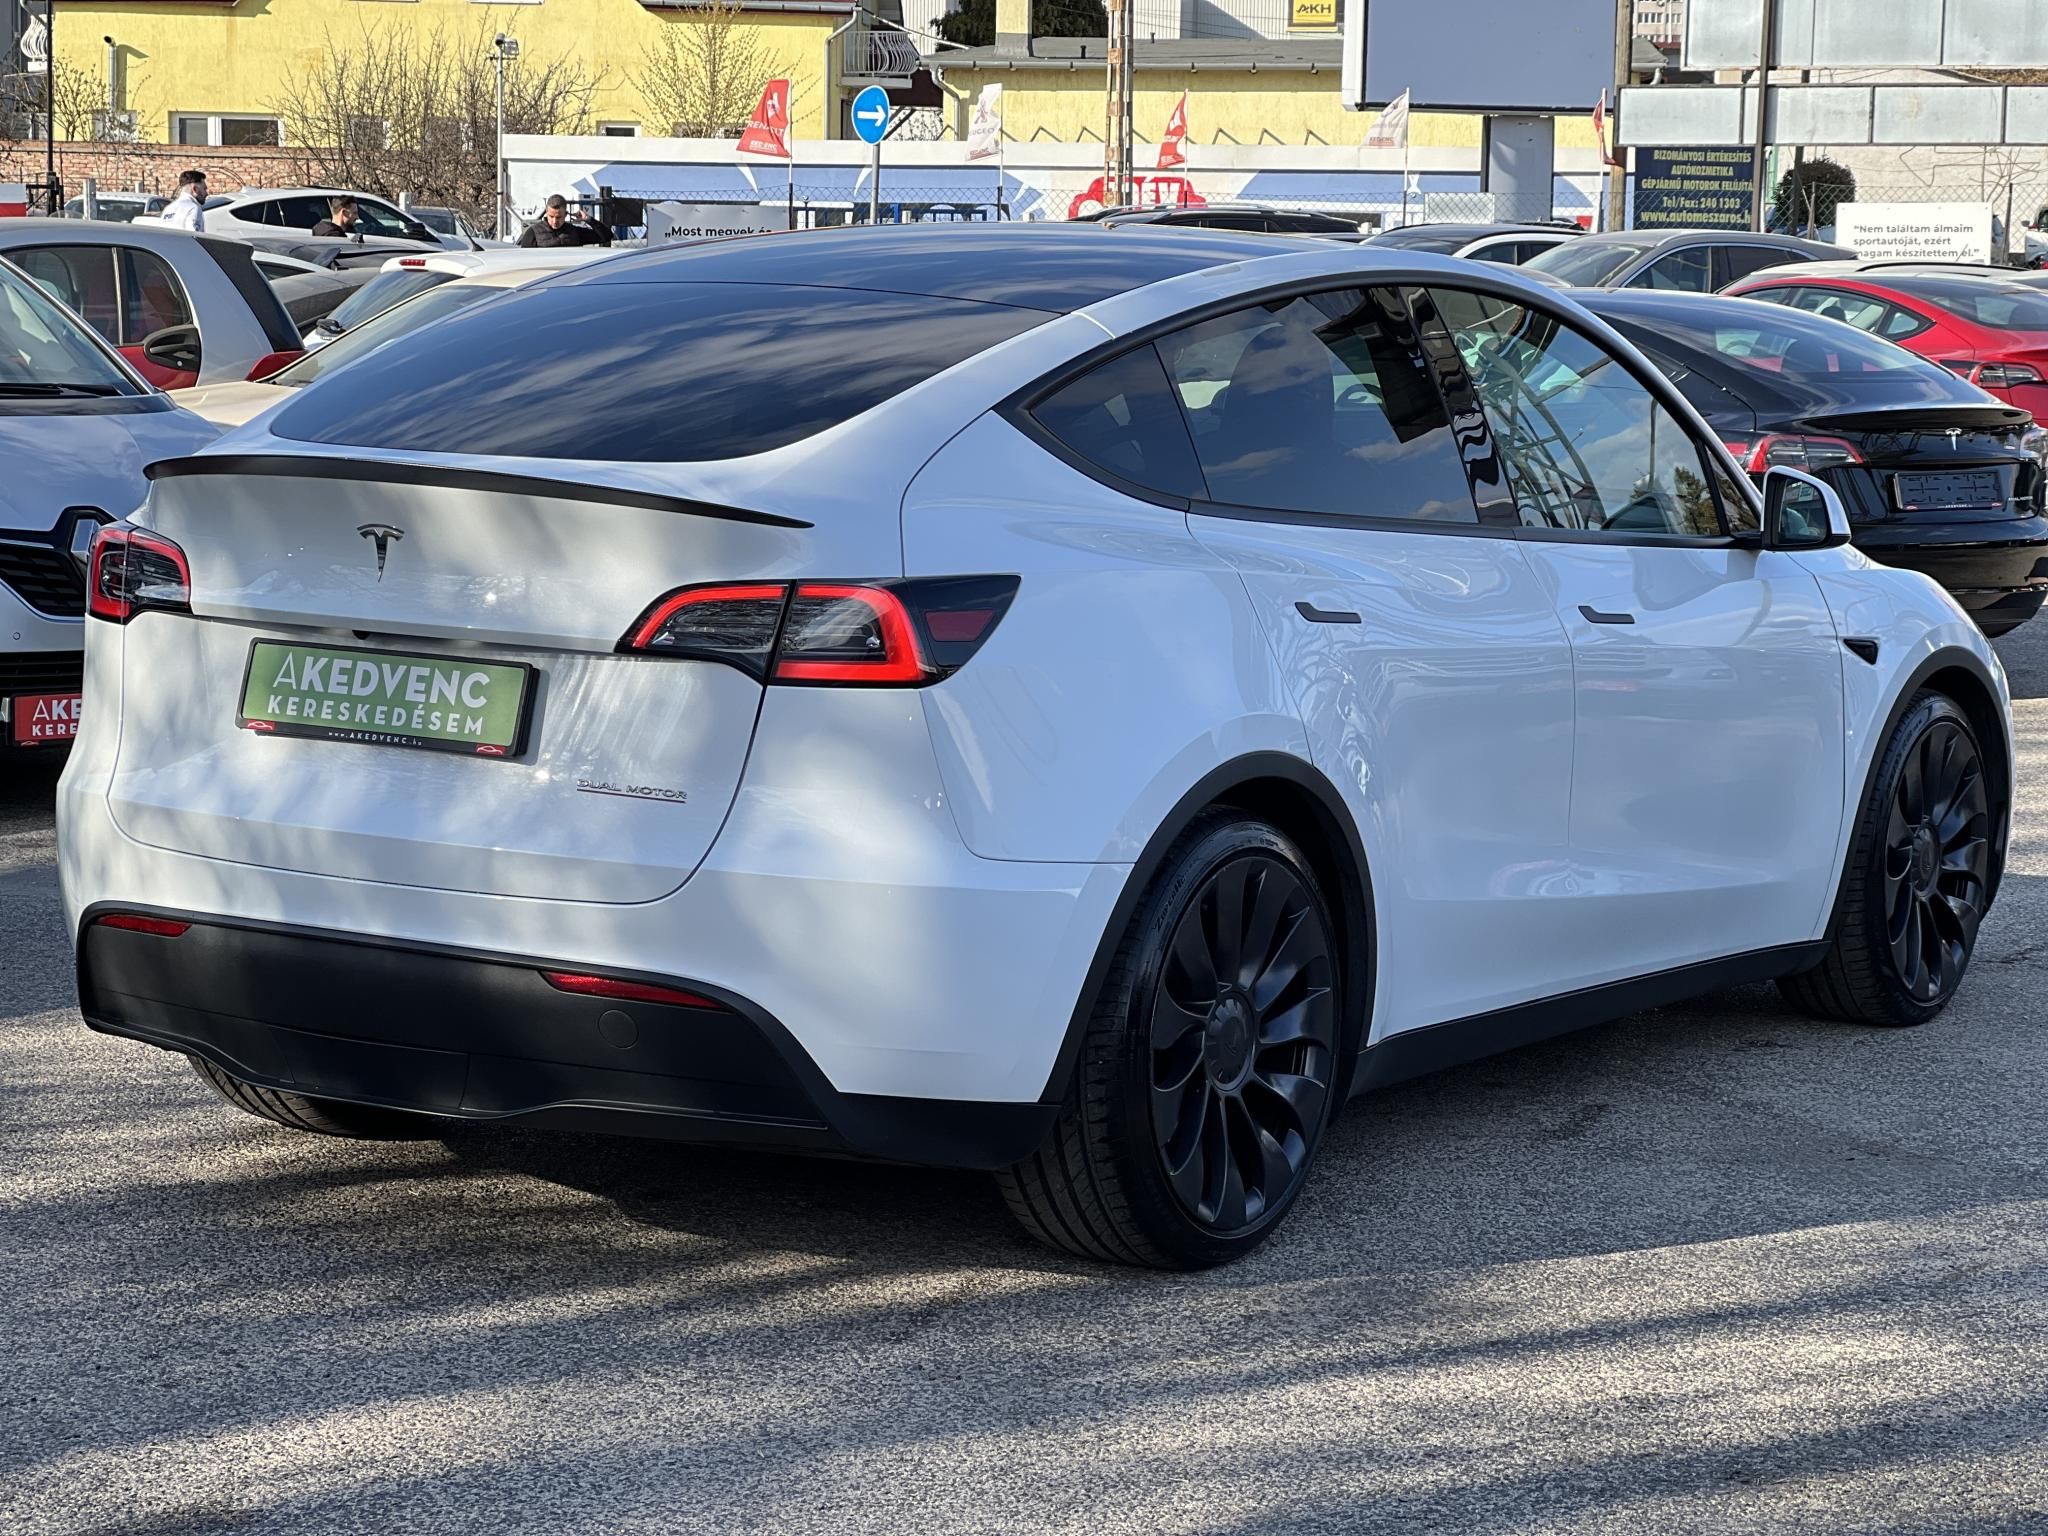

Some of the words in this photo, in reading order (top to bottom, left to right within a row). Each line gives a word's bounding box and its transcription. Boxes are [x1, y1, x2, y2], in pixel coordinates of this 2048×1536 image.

[1653, 148, 1705, 162] BIZOMÁNYOSI
[1706, 149, 1752, 163] ÉRTÉKESÍTÉS
[1671, 163, 1734, 177] AUTÓKOZMETIKA
[1682, 180, 1721, 191] MOTOROK
[1721, 179, 1755, 192] FELÚJÍTÁ
[1662, 196, 1699, 209] Tel/Fax:
[1701, 197, 1718, 209] 240
[1719, 197, 1741, 209] 1303
[1641, 210, 1753, 224] www.automeszaros.h
[1886, 224, 1931, 234] találtam
[1933, 224, 1974, 234] álmaim
[1853, 236, 1921, 247] sportautóját,
[1924, 237, 1952, 246] ezért
[272, 651, 491, 709] AKEDVENC
[267, 694, 484, 737] KERESKEDÉSEM
[576, 779, 622, 792] DUAL
[625, 784, 688, 800] MOTOR
